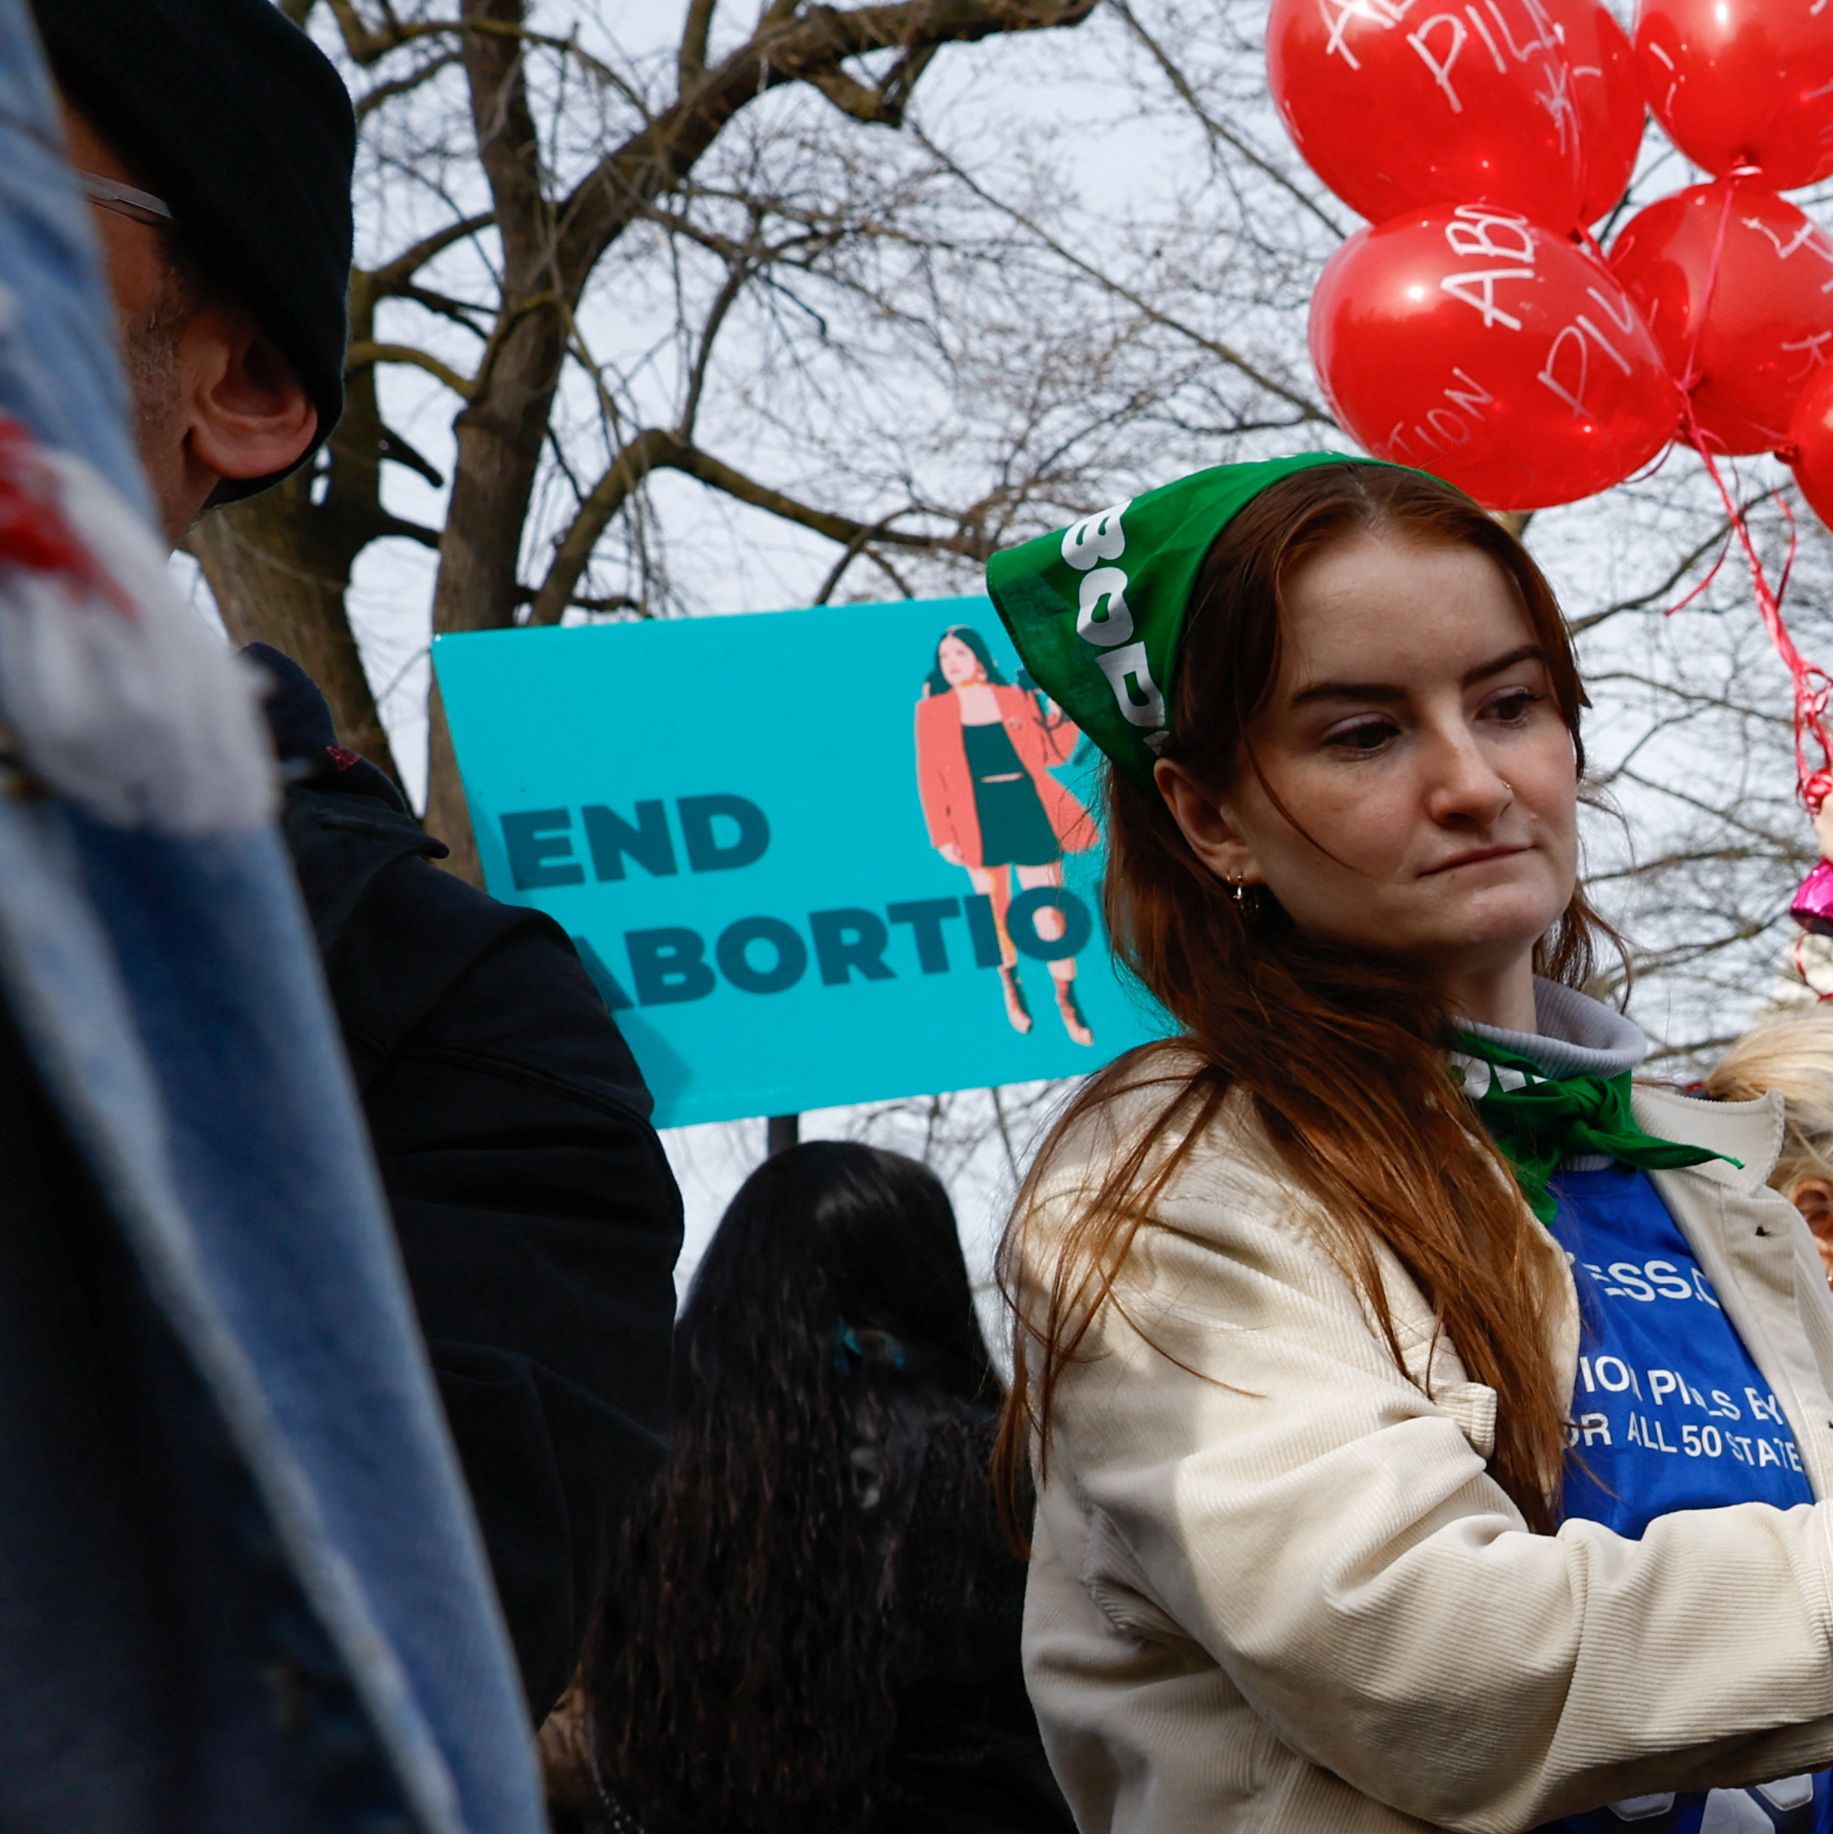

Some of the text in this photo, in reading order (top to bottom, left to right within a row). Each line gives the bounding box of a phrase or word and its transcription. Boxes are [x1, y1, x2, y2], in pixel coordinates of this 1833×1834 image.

[498, 793, 770, 891] END
[572, 882, 1108, 1010] BORTIO
[1627, 1411, 1678, 1453] ALL
[1682, 1424, 1722, 1458] 50
